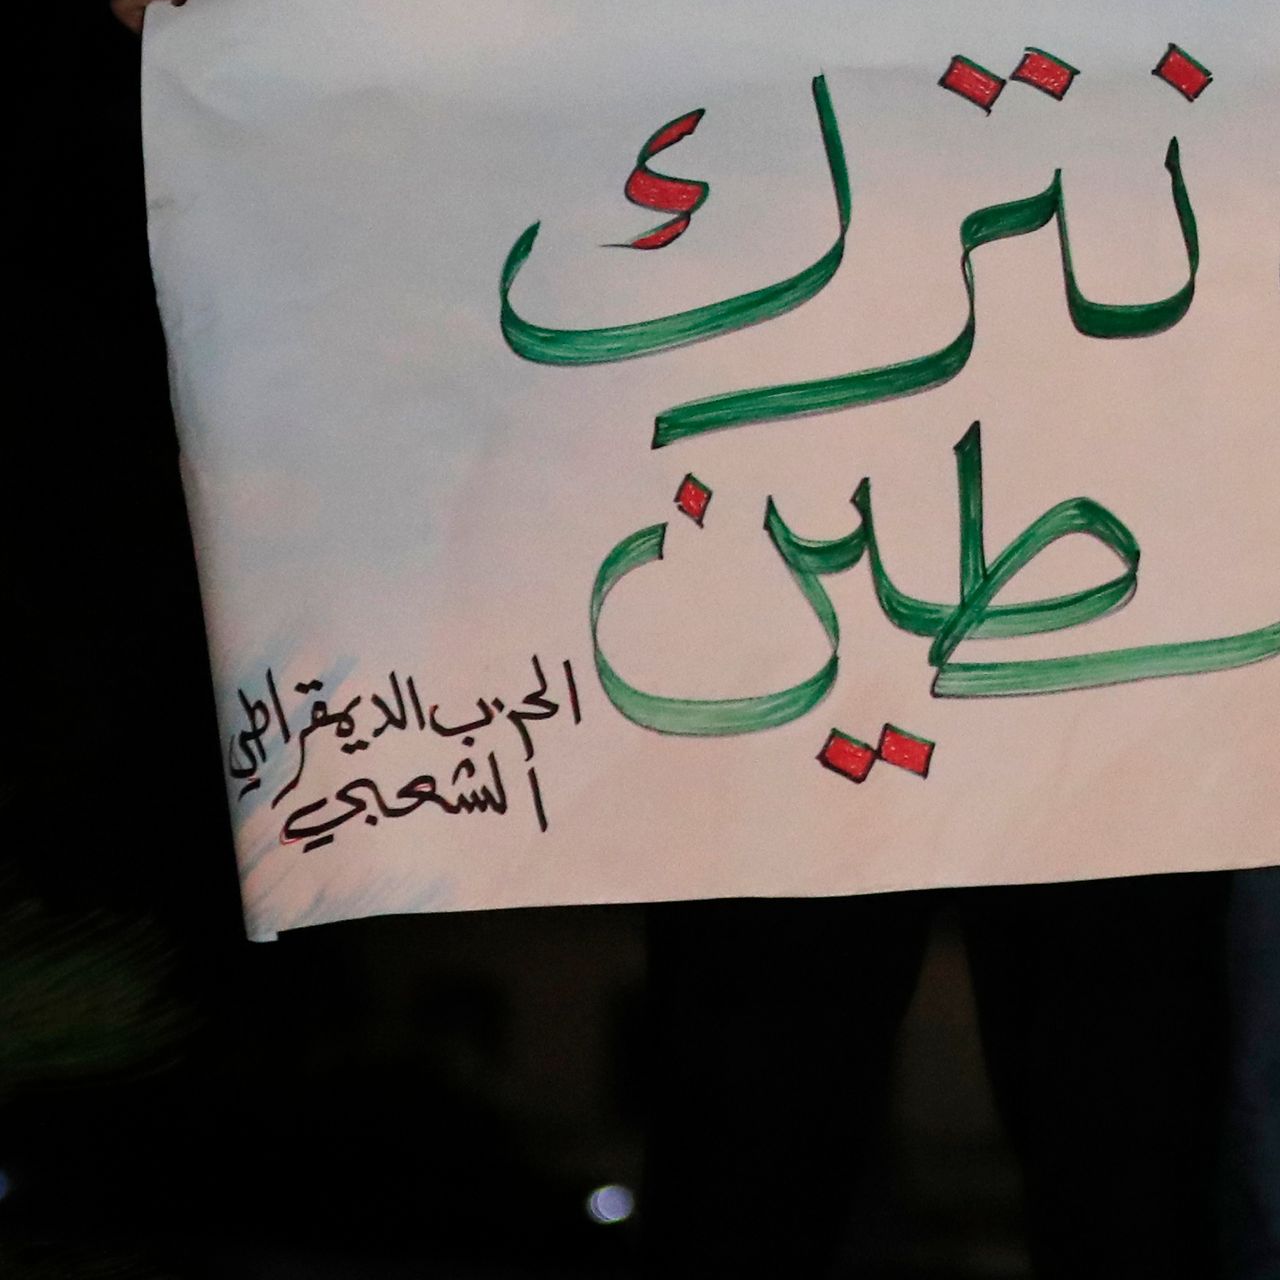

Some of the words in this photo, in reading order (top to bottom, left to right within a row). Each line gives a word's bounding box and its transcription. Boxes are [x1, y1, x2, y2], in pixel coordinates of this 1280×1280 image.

[497, 43, 1212, 450] نترك
[428, 654, 582, 762] الحزب
[278, 750, 549, 854] الشعبي
